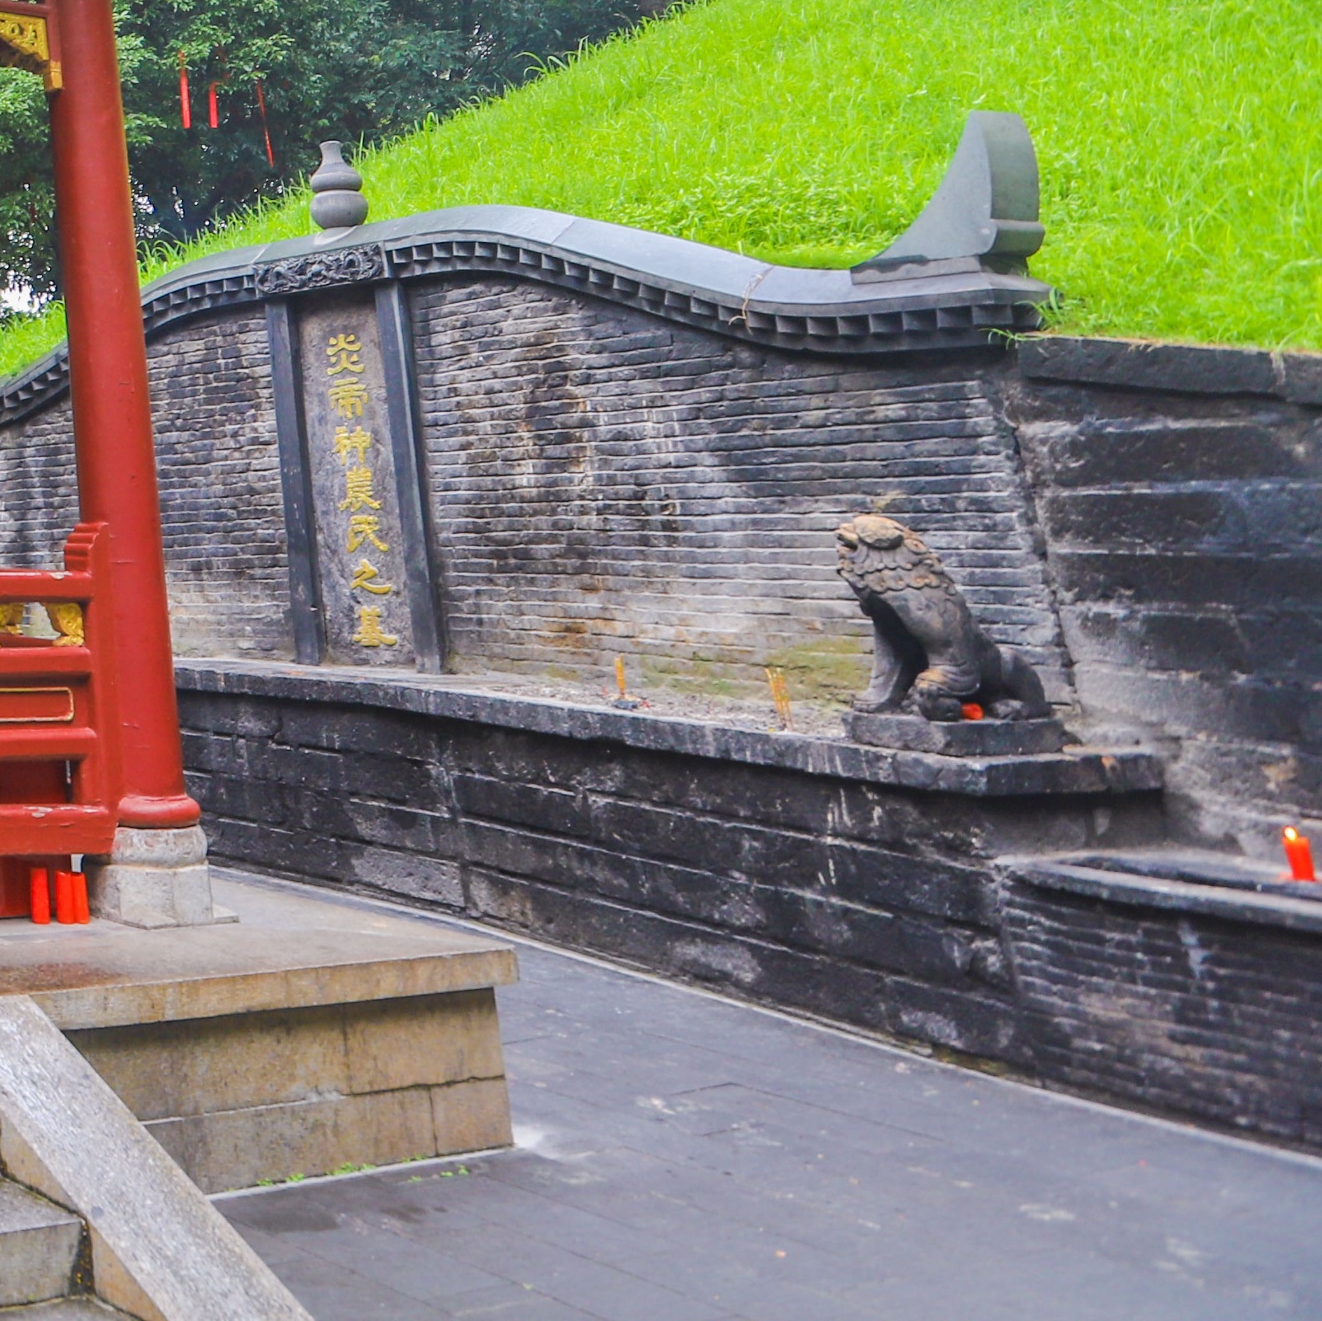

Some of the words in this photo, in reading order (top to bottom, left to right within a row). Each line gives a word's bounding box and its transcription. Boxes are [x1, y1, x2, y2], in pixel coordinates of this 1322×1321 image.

[325, 333, 398, 647] 炎帝神農氏之墓
